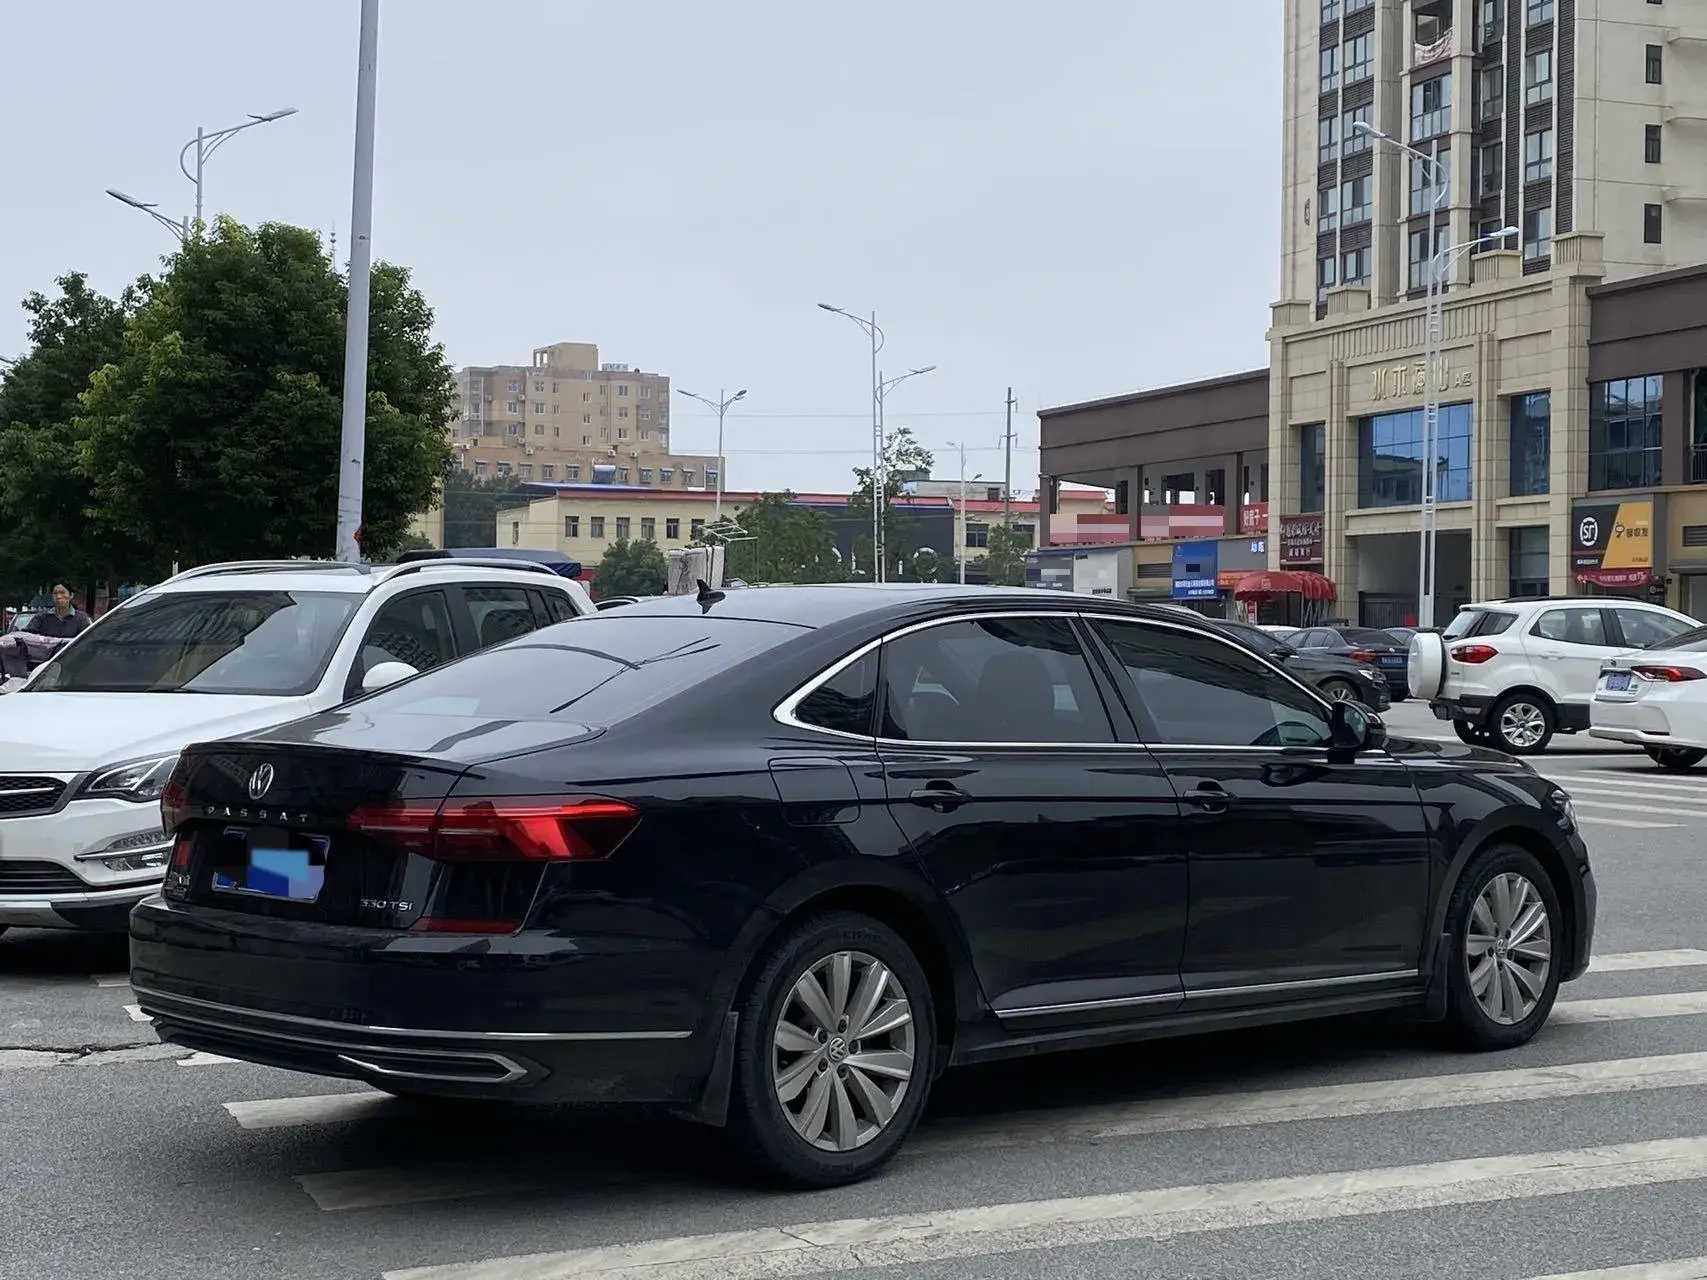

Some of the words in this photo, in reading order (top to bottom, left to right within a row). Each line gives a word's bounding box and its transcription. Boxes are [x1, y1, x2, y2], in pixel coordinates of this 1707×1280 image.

[207, 806, 309, 823] PASSAT
[360, 898, 387, 909] 330
[390, 901, 413, 911] TSI
